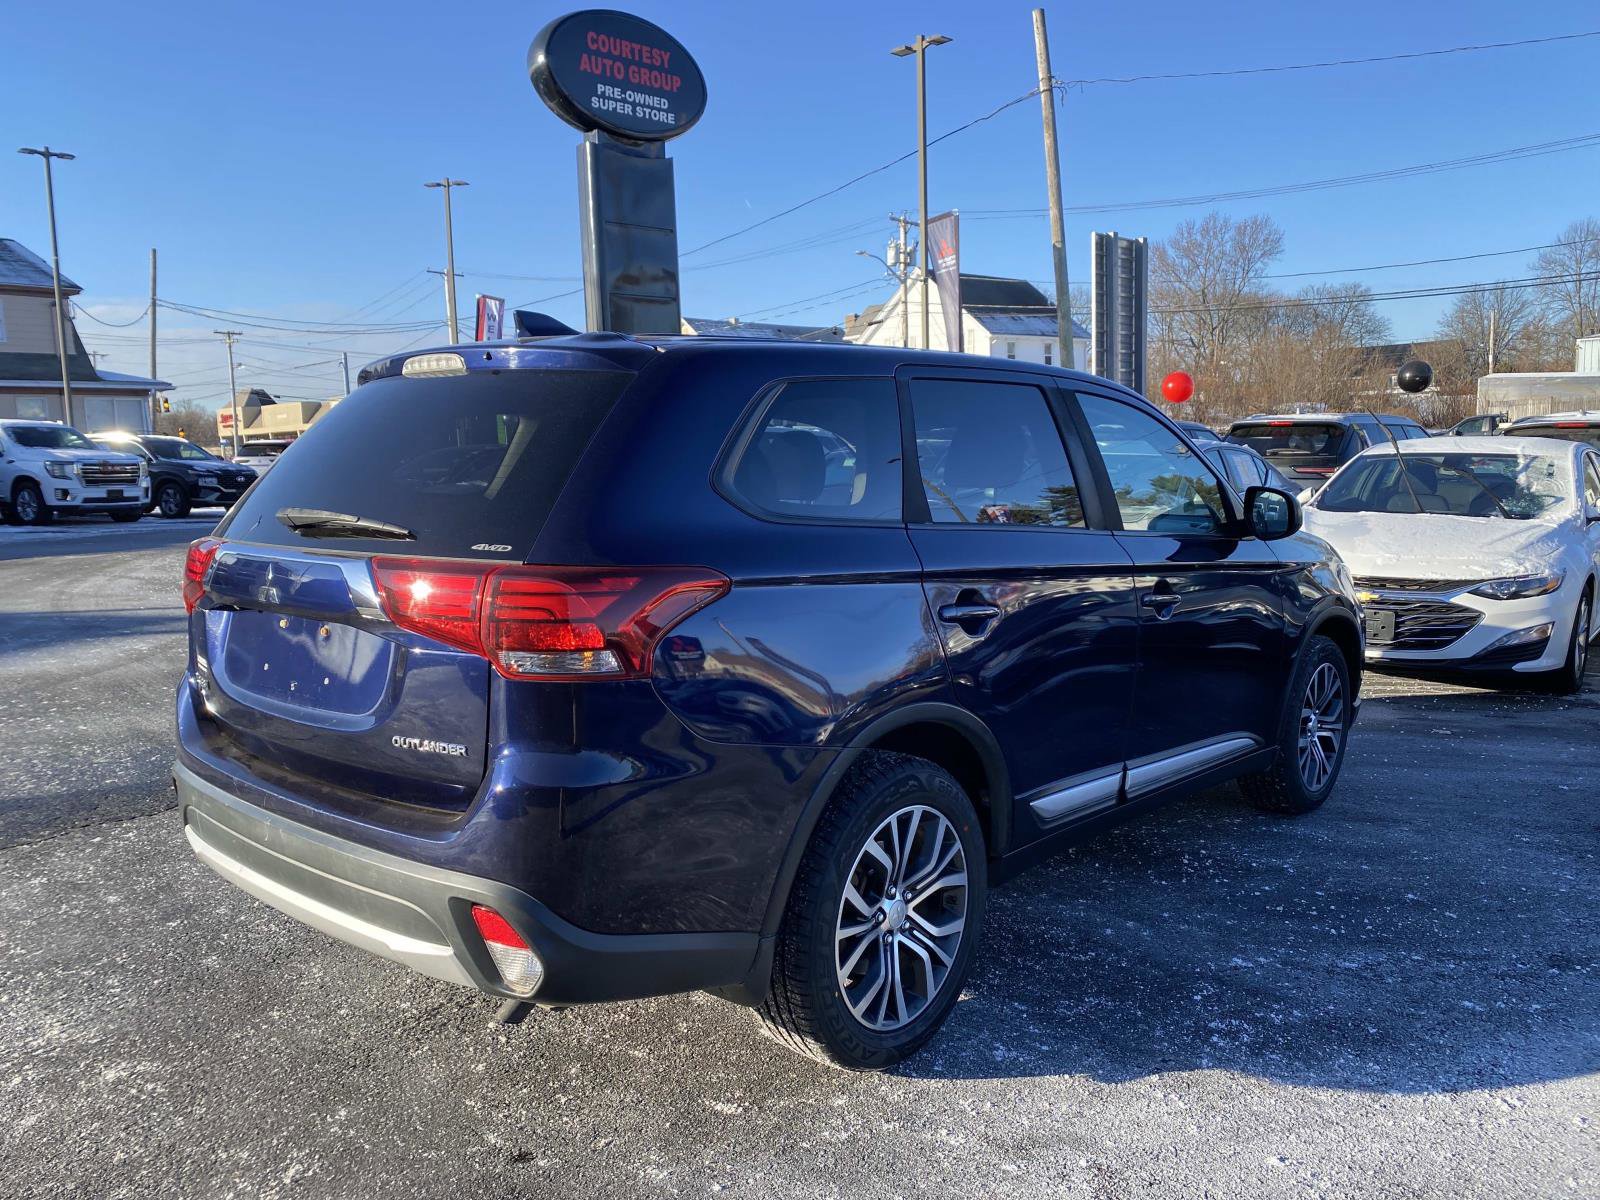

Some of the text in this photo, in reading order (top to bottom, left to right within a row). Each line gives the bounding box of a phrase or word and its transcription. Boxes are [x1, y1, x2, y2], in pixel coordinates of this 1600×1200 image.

[586, 31, 671, 69] COURTESY
[579, 53, 681, 92] AUTO GROUP
[591, 96, 676, 124] SUPER STORE
[597, 83, 669, 110] PRE-OWNED
[471, 543, 513, 552] 4WD
[391, 735, 468, 757] OUTLANDER
